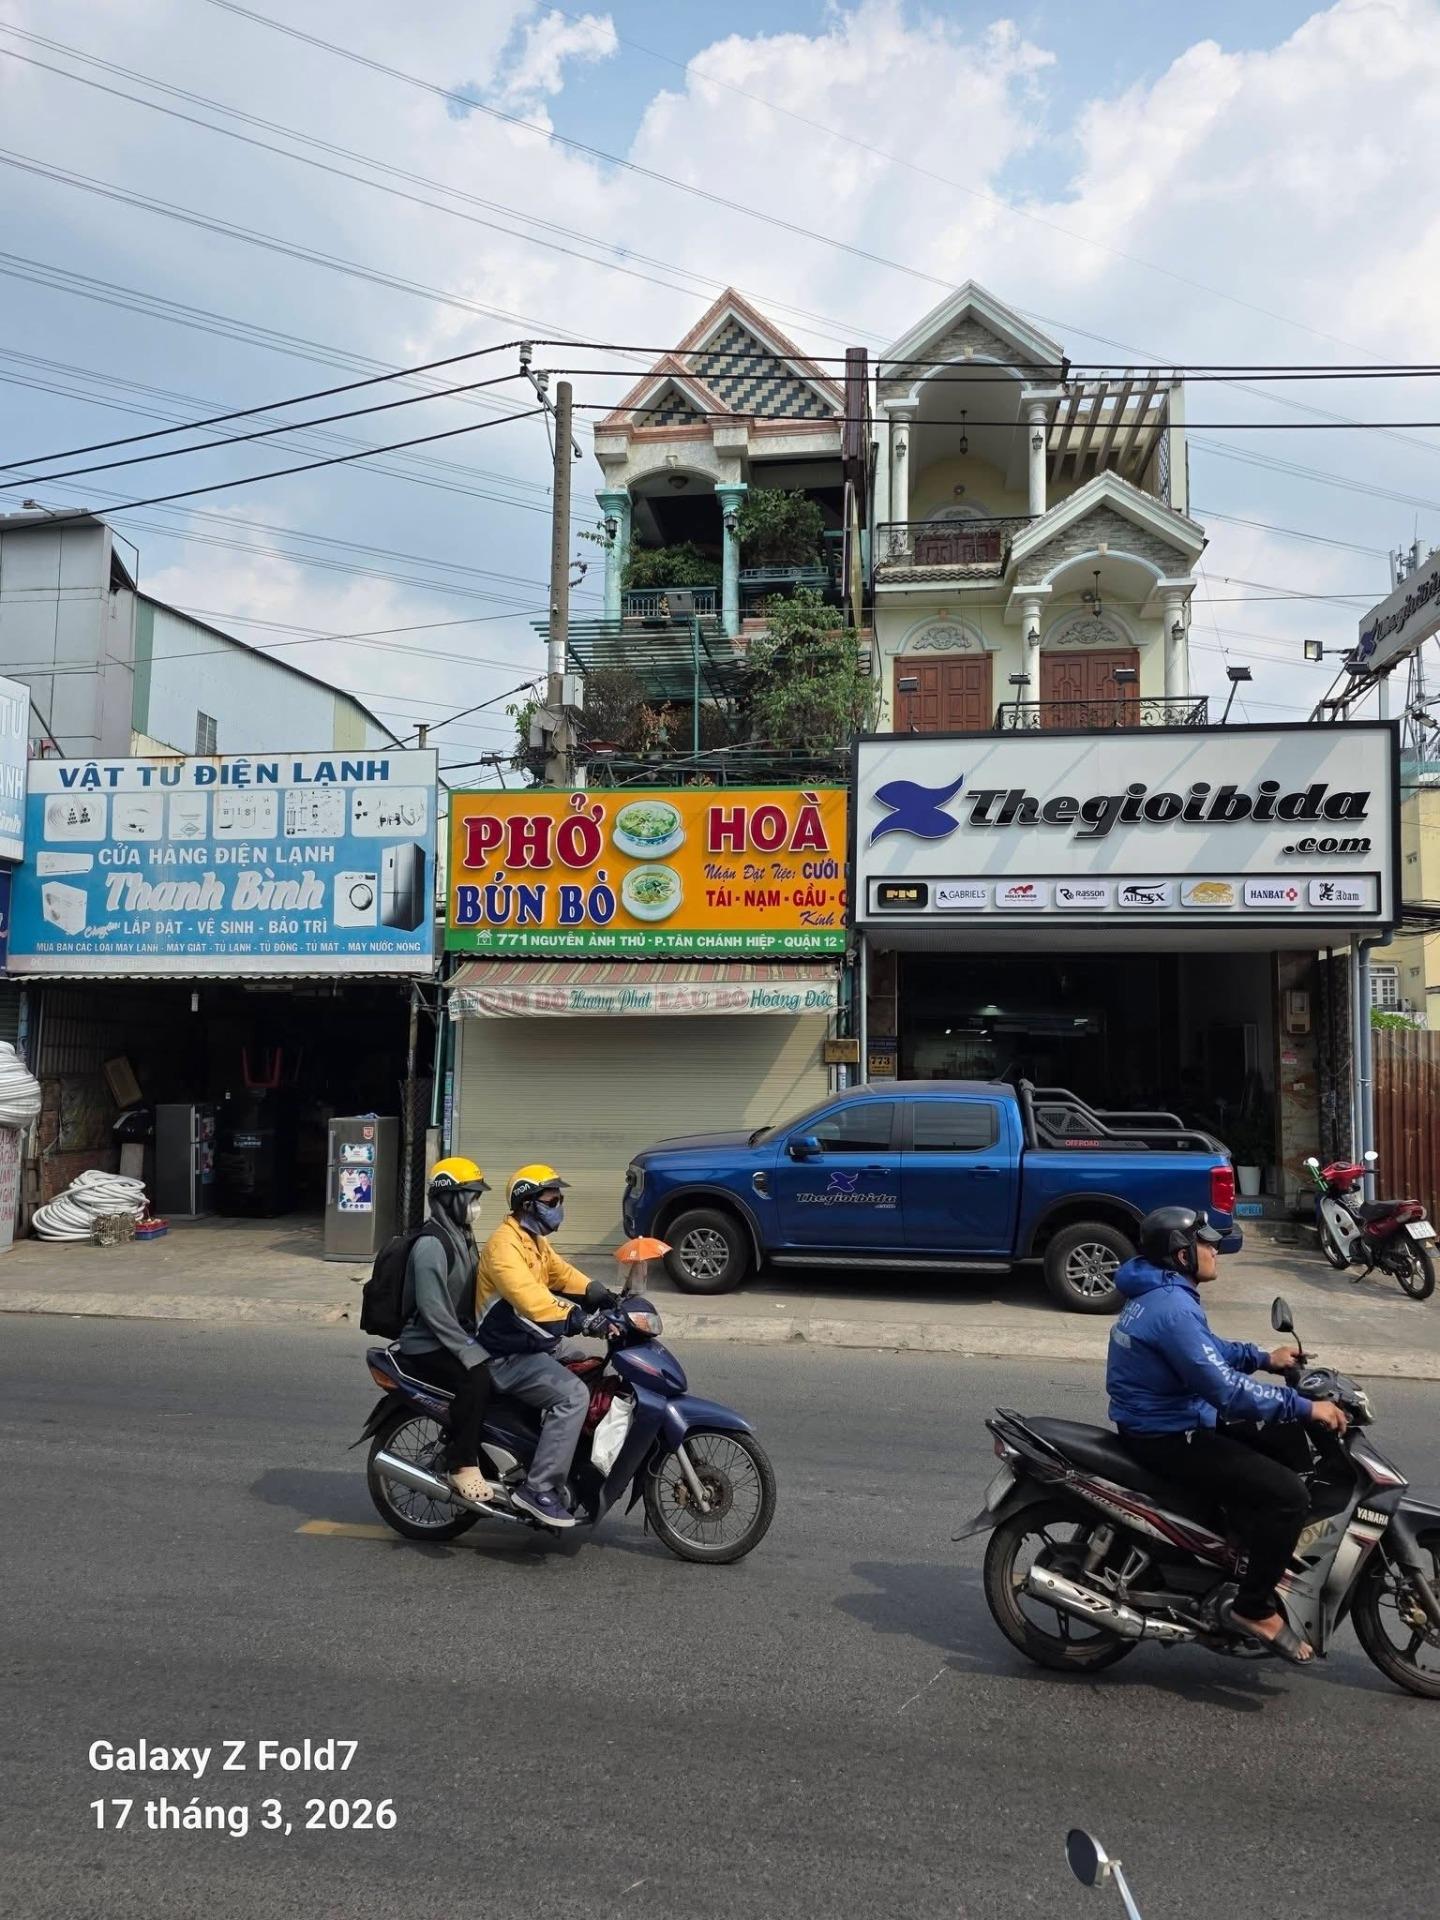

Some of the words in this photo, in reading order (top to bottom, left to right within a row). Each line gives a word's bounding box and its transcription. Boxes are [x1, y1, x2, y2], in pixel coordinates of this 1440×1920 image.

[59, 762, 124, 791] VẬT
[137, 761, 186, 787] TƯ
[194, 758, 279, 789] ĐIỆN
[293, 759, 390, 786] LẠNH
[963, 780, 1371, 840] Thegioibida
[462, 792, 607, 869] PHỞ
[708, 791, 830, 853] HOÀ
[98, 840, 142, 866] CỬA
[148, 842, 208, 866] HÀNG
[215, 842, 264, 868] ĐIỆN
[276, 845, 336, 866] LẠNH
[1283, 834, 1372, 856] .com
[704, 863, 737, 882] Nhận
[743, 864, 766, 882] Đặt
[771, 863, 797, 882] Tiệc:
[802, 858, 839, 880] CƯỚI
[104, 871, 226, 911] Thanh
[231, 867, 326, 911] Bình
[455, 870, 549, 925] BÚN
[557, 869, 618, 925] BÒ
[706, 885, 732, 907] TÁI
[744, 889, 781, 912] NẠM
[793, 882, 827, 907] GẦU
[948, 889, 986, 899] GABRIELS
[1335, 889, 1360, 901] Adam
[124, 916, 151, 935] LẮP
[156, 918, 183, 937] ĐẶT
[198, 918, 216, 936] VỆ
[220, 920, 254, 934] SINH
[268, 916, 299, 934] BẢO
[303, 916, 327, 934] TRÌ
[800, 911, 835, 926] Kính
[36, 943, 54, 952] MUA
[497, 933, 528, 946] 771
[530, 931, 584, 946] NGUYỄN
[589, 932, 616, 946] ẢNH
[620, 932, 646, 946] THỦ
[654, 933, 693, 947] P.TÂN
[697, 933, 743, 947] CHÁNH
[746, 933, 776, 950] HIỆP
[784, 934, 821, 950] QUẬN
[824, 936, 837, 947] 12
[750, 988, 801, 1014] Hoàng
[870, 1056, 890, 1065] 773
[1357, 1507, 1389, 1526] YAMAHA
